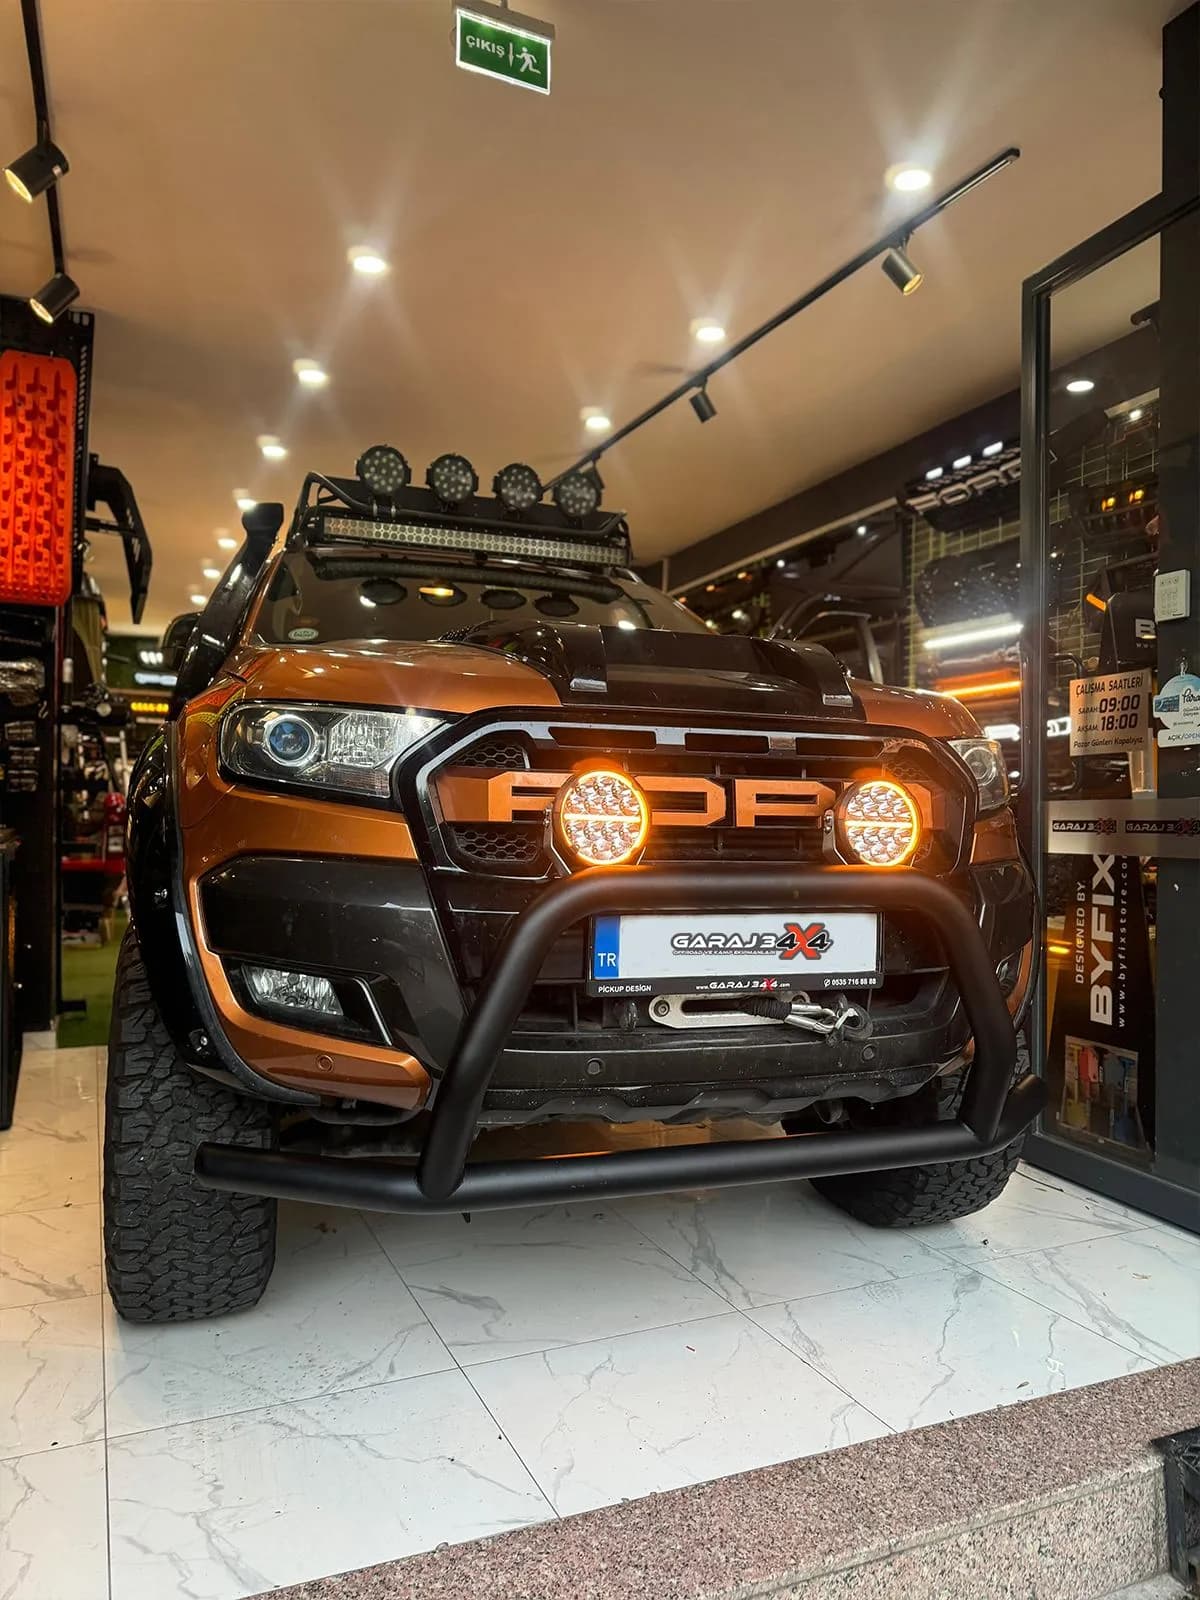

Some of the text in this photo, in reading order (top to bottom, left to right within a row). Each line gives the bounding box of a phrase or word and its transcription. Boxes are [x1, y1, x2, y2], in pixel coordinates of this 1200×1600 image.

[465, 35, 505, 58] ÇIKIŞ
[1075, 673, 1144, 698] ÇALIŞMA SAATLERİ
[1100, 694, 1140, 713] 09:00
[1100, 713, 1138, 731] 18:00
[1073, 740, 1091, 748] Pazar
[1091, 738, 1113, 747] Günleri
[1075, 881, 1087, 984] DESIGNED BY
[1090, 854, 1115, 1026] BYFIX
[597, 953, 617, 967] TR
